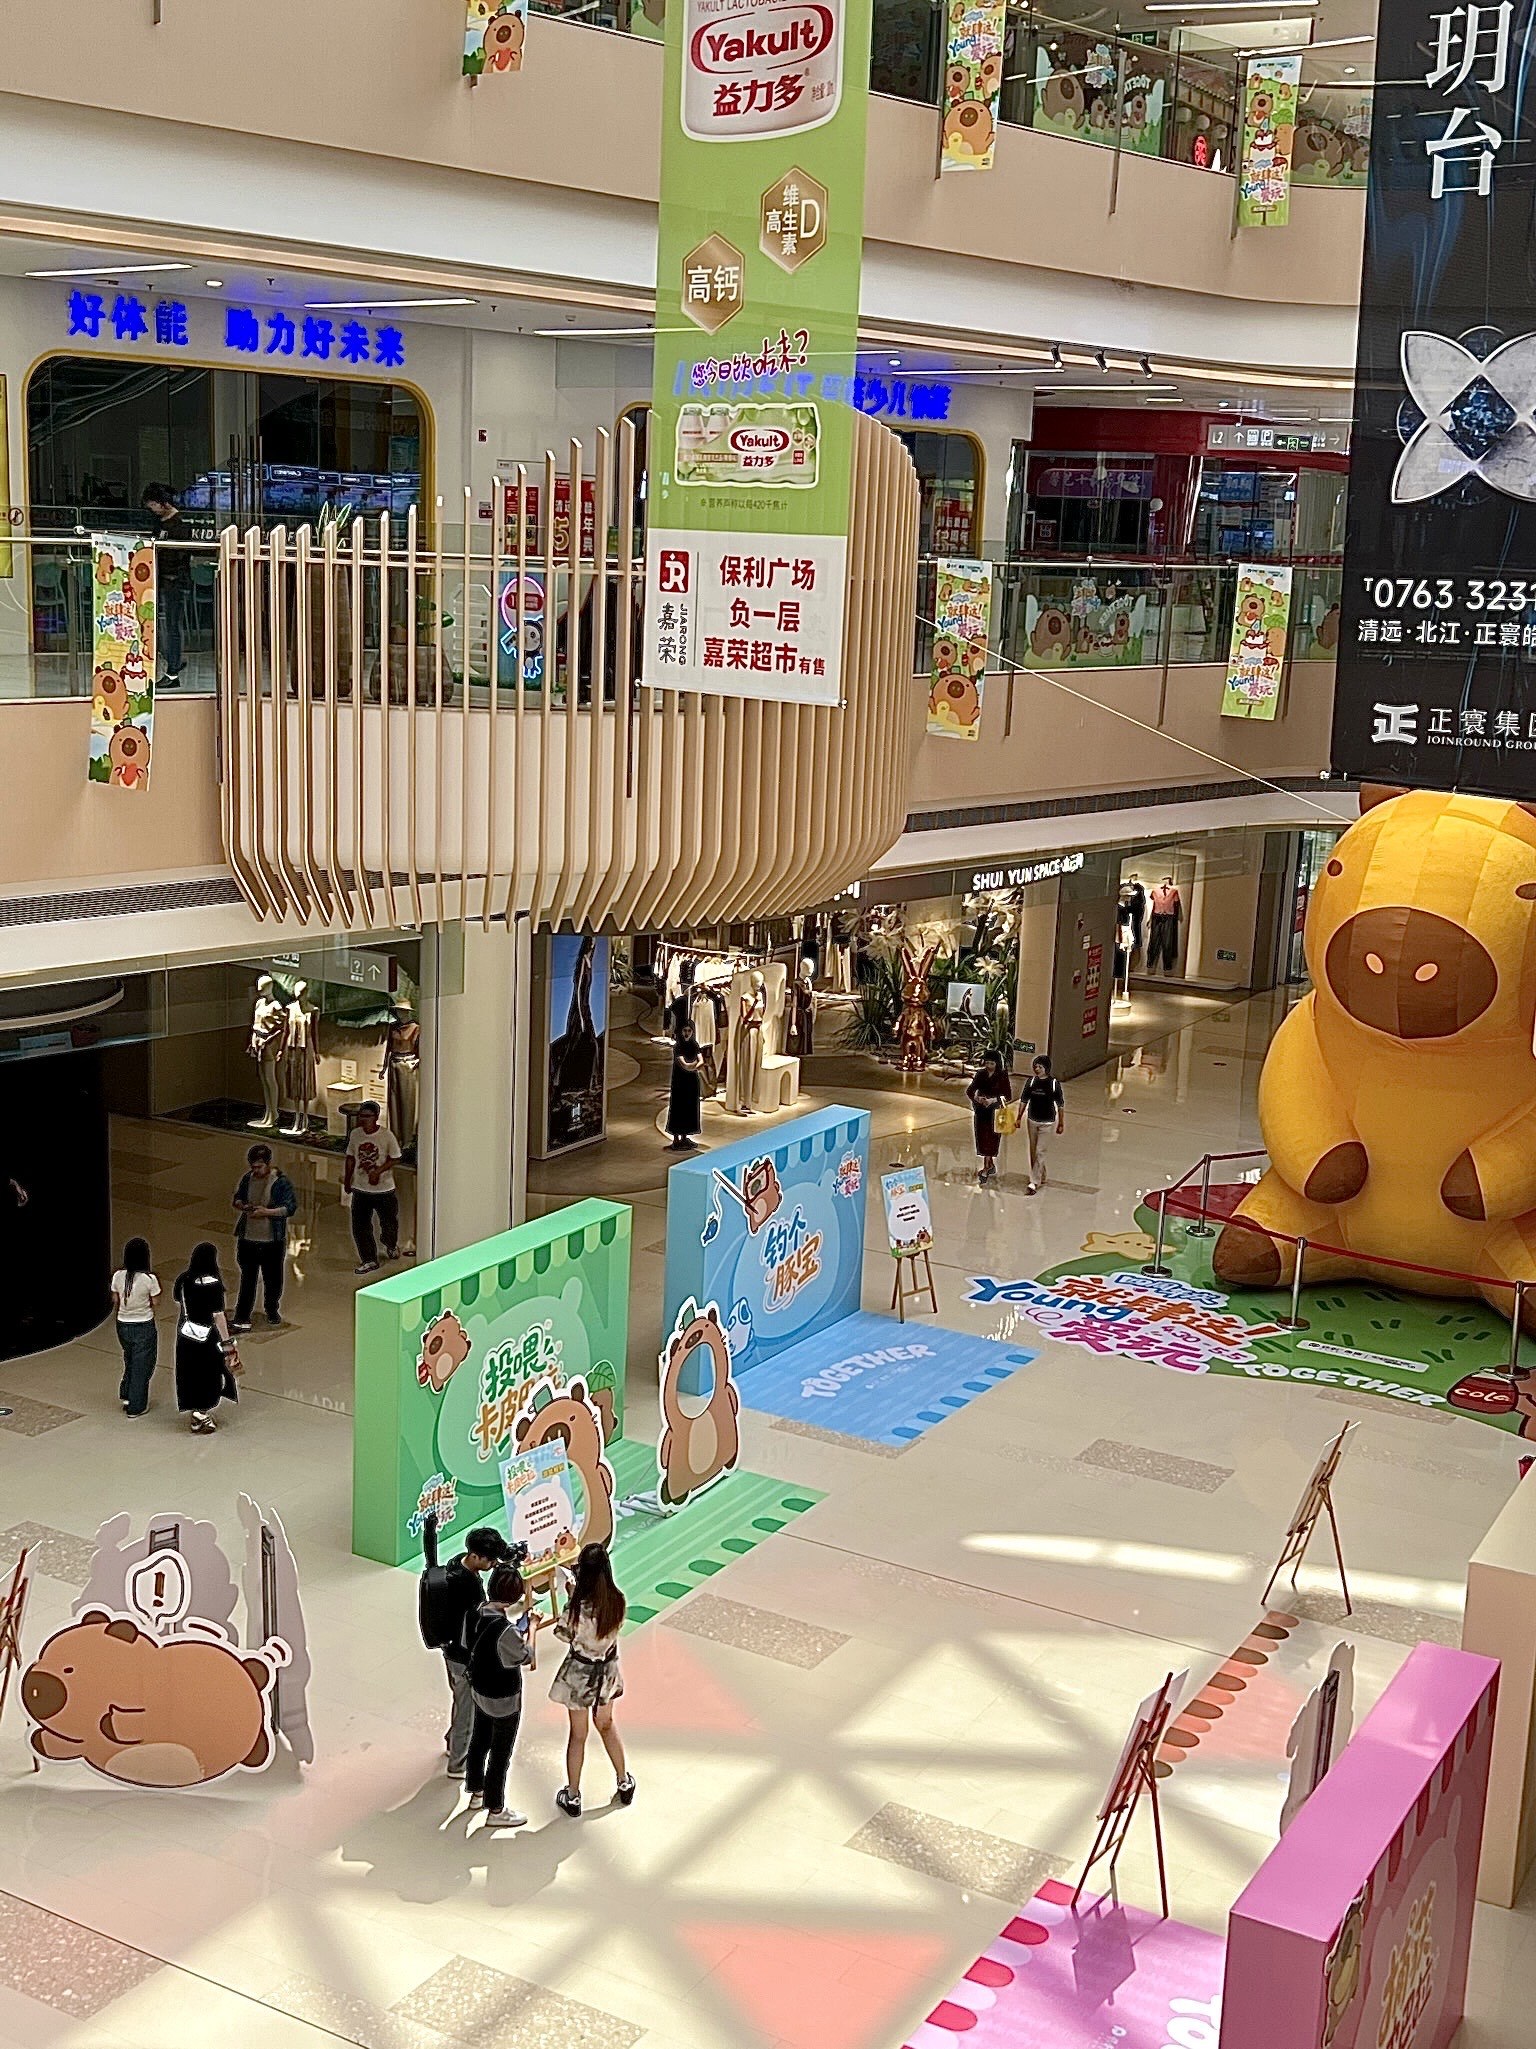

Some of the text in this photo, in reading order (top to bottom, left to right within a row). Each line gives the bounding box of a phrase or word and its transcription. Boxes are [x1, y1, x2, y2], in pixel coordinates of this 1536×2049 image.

[706, 18, 820, 62] Yakult
[712, 73, 804, 116] 益力多
[687, 264, 740, 304] 高钙
[68, 290, 405, 367] 好体能 助力好未来
[740, 434, 781, 449] Yakult
[1212, 431, 1223, 444] L2
[742, 455, 775, 468] 益力多
[719, 554, 816, 591] 保利广场
[678, 603, 688, 666] JIARONG
[729, 597, 801, 633] 负一层
[1427, 735, 1502, 748] JOINROUND
[972, 871, 1004, 891] SHUI
[1007, 867, 1033, 886] YUN
[969, 1278, 1133, 1322] Young
[1048, 1313, 1203, 1372] 爱玩
[801, 1343, 937, 1398] TOGETHER
[1233, 1362, 1447, 1406] TOGETHER
[1454, 1388, 1510, 1403] cola
